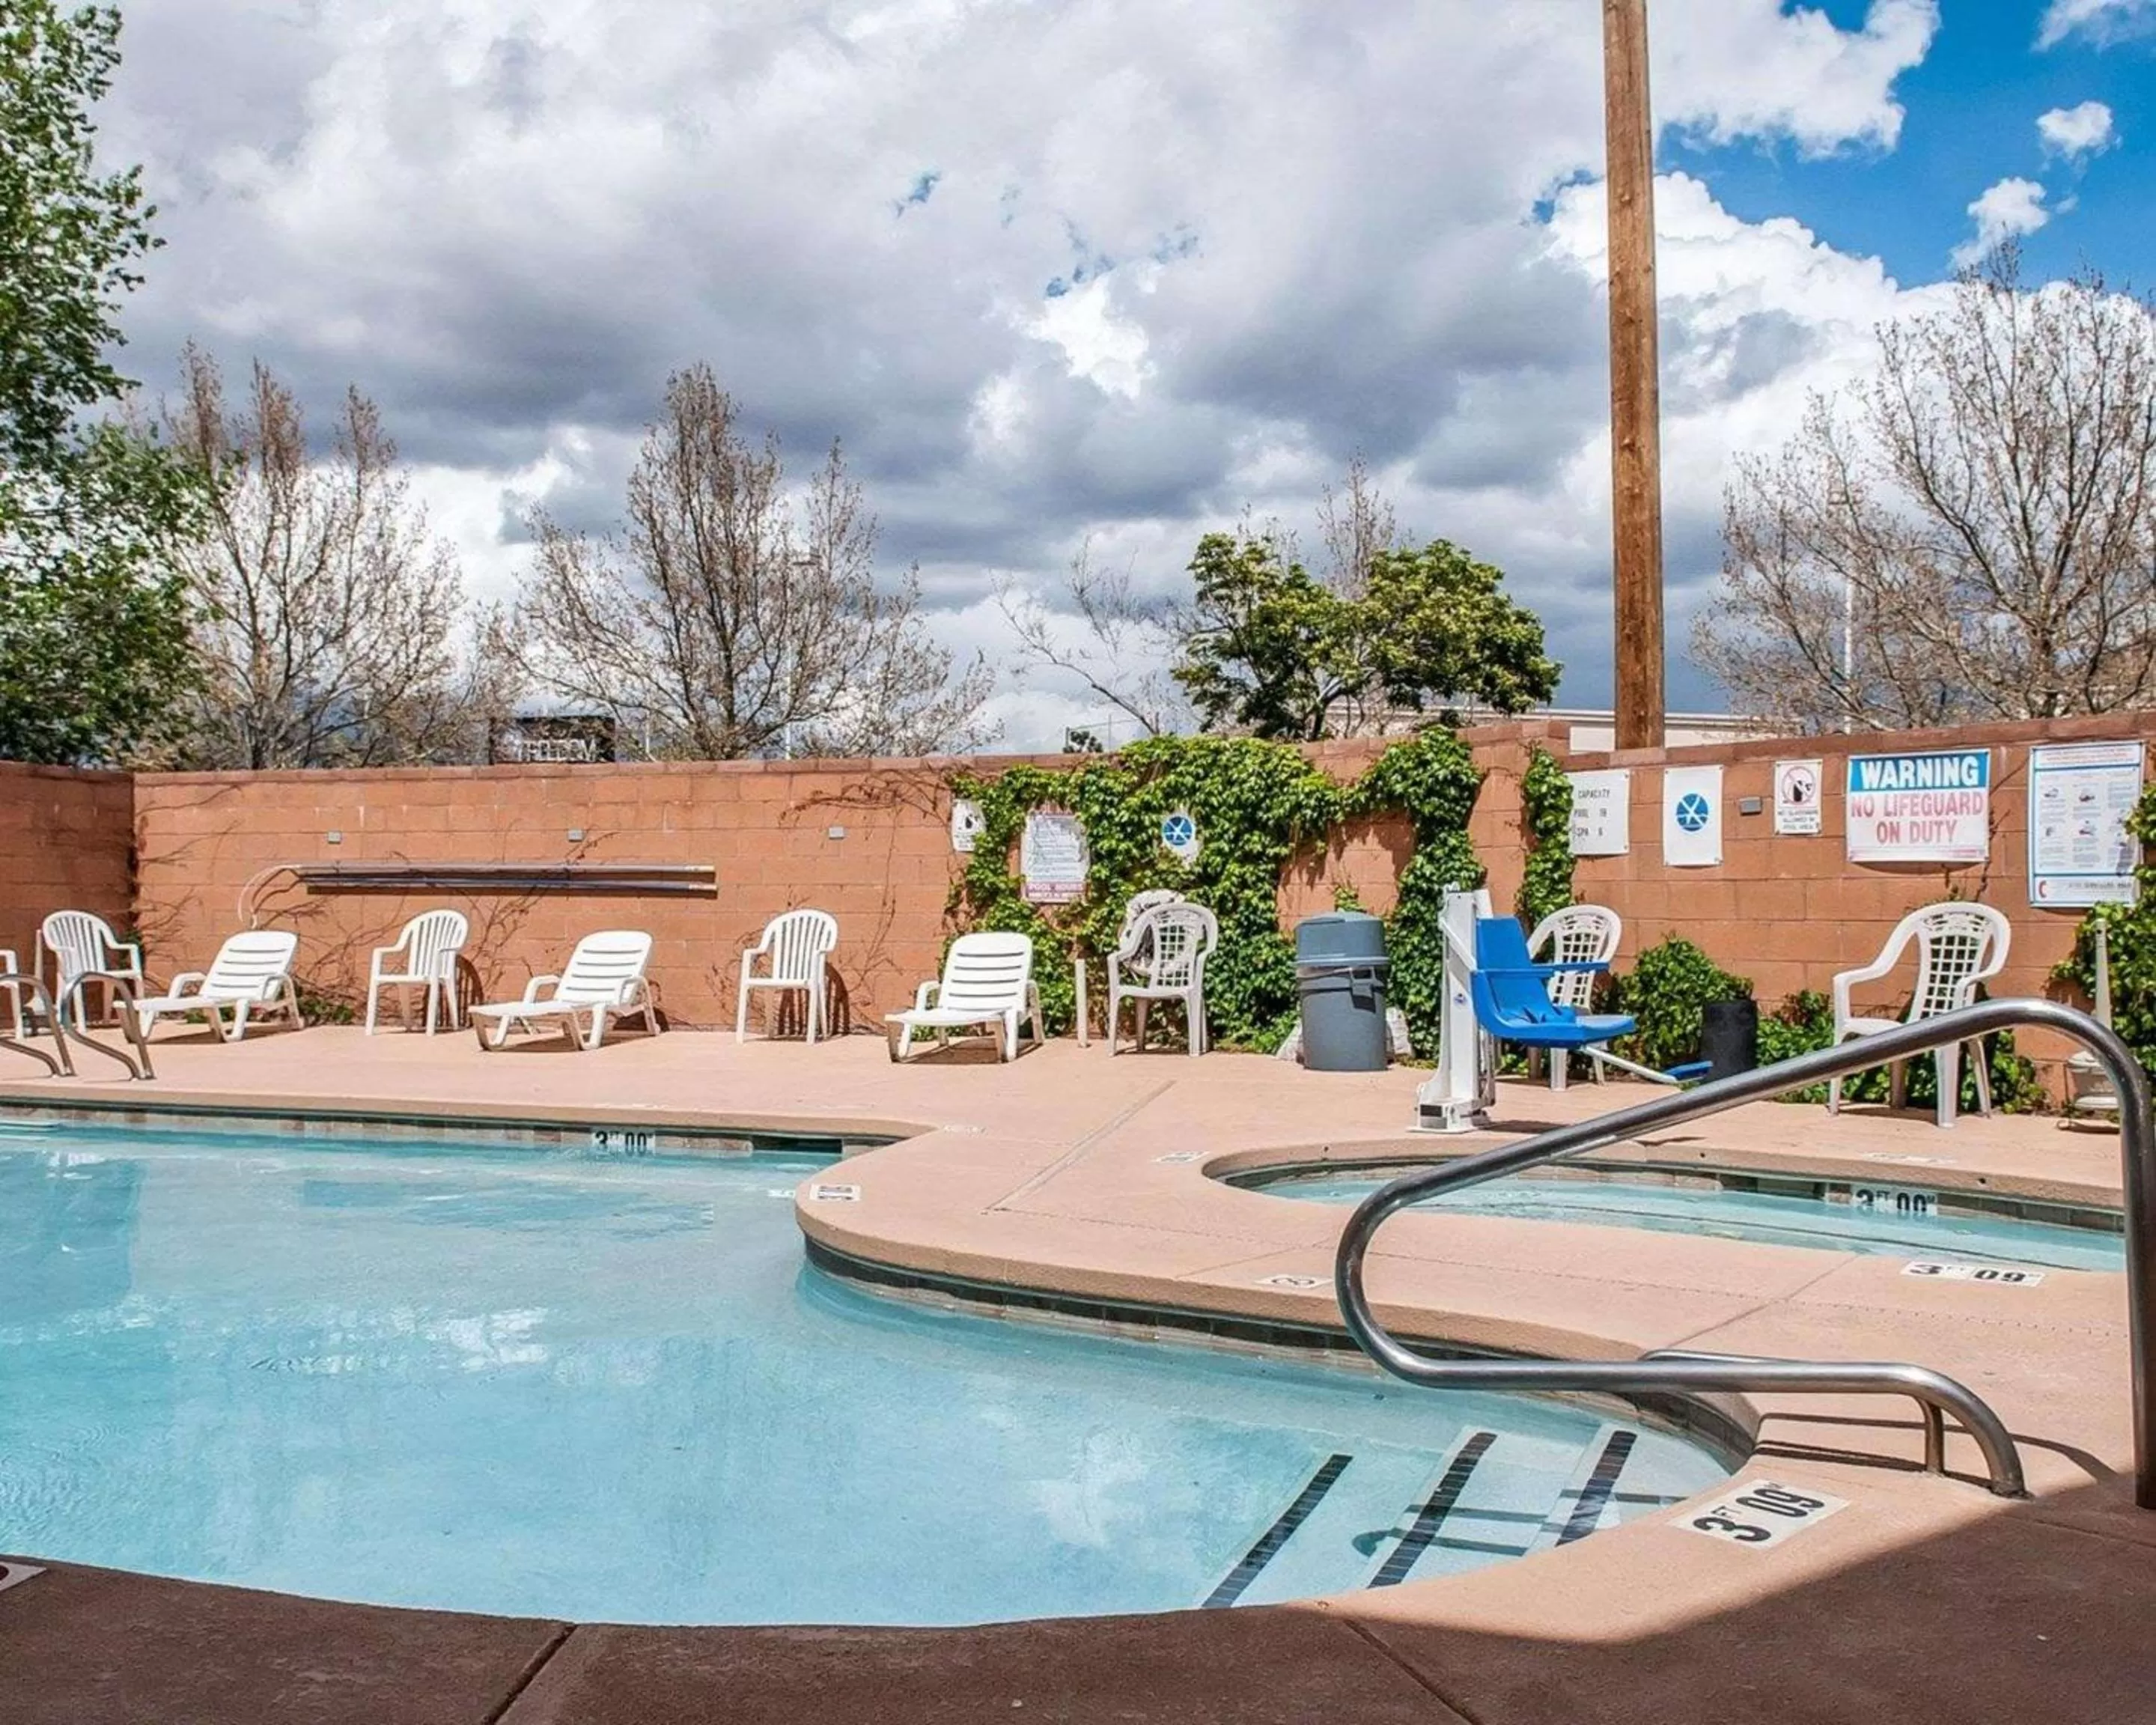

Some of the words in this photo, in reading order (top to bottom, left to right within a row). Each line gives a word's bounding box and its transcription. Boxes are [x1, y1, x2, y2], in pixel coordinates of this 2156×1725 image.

[1860, 755, 1979, 789] WARNING
[1851, 795, 1875, 818] NO
[1884, 792, 1984, 818] LIFEGUARD
[1877, 821, 1901, 845] ON
[1909, 820, 1958, 844] DUTY
